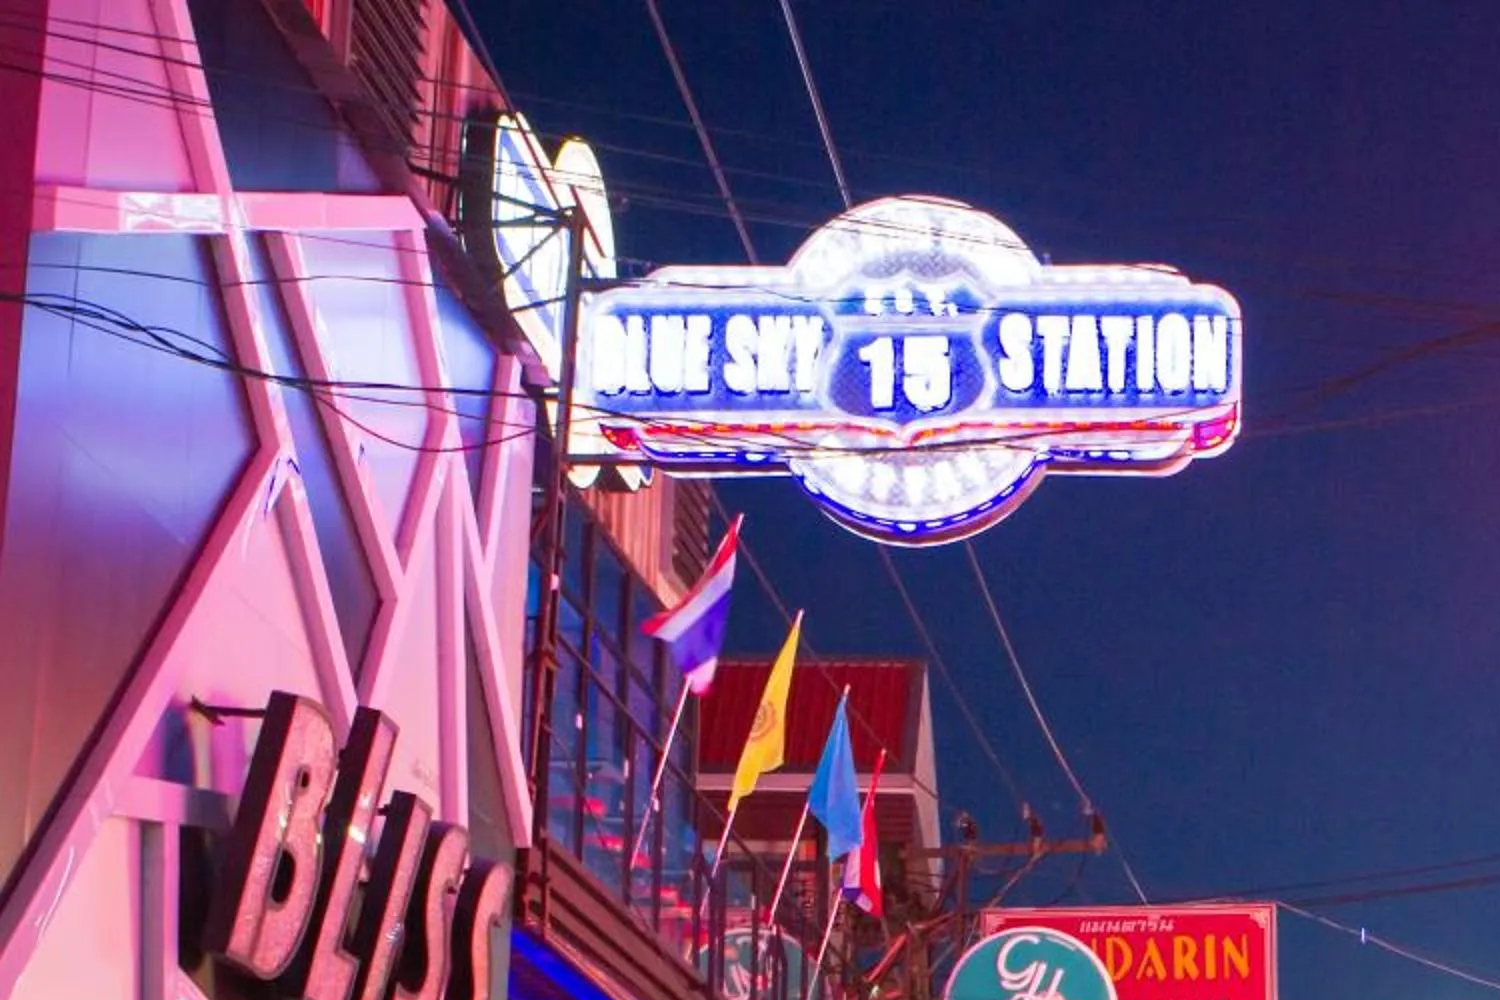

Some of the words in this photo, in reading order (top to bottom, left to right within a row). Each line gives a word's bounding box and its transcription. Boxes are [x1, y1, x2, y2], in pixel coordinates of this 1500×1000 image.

[858, 335, 952, 413] 15
[999, 312, 1228, 396] STATION
[1091, 933, 1250, 982] DARIN
